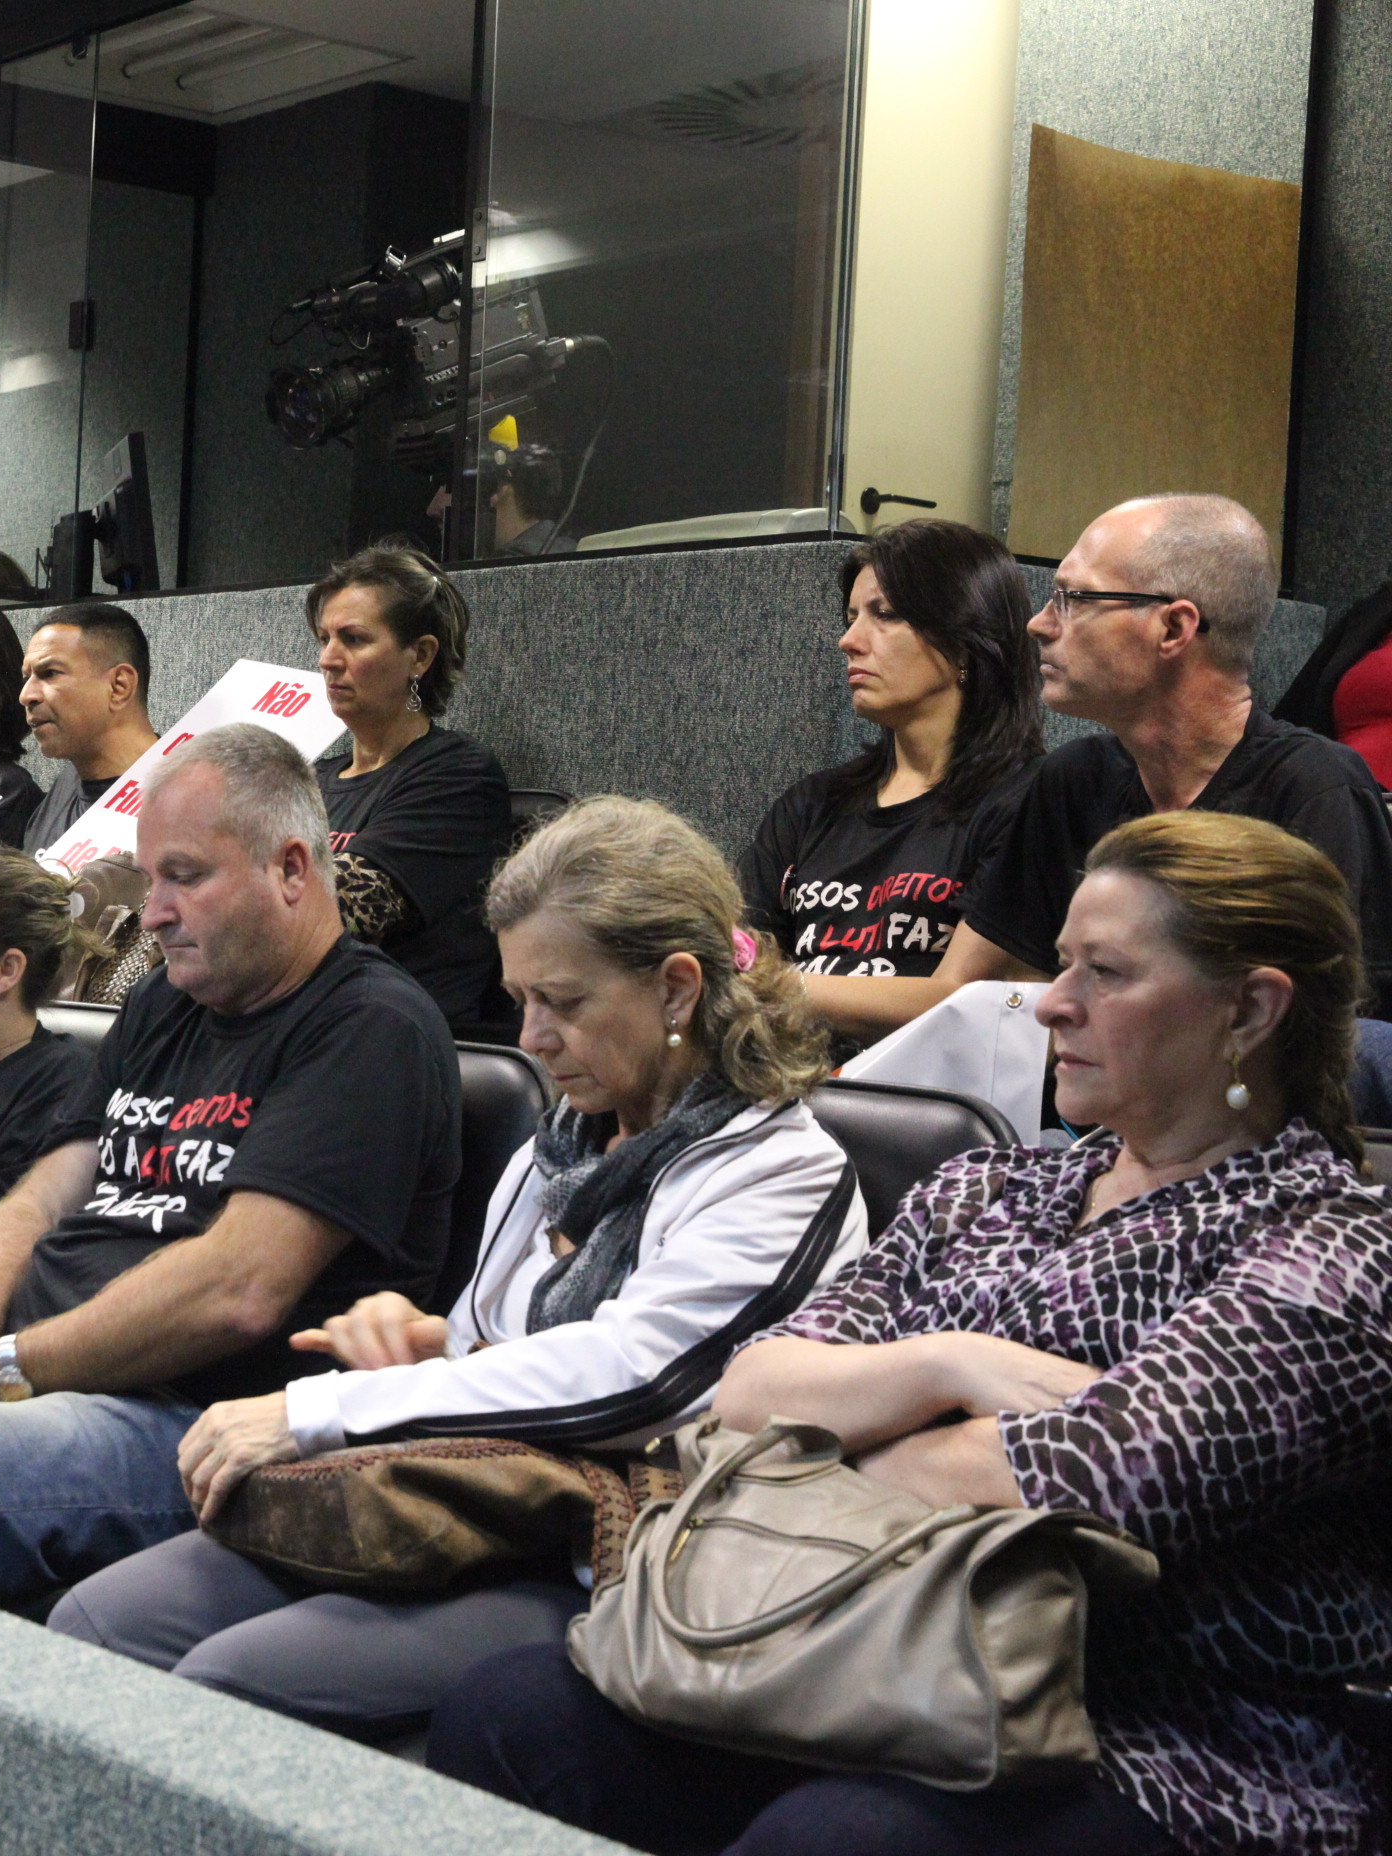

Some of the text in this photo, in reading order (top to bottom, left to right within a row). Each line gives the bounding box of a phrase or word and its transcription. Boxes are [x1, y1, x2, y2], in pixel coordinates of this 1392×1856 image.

[251, 681, 312, 718] Não
[819, 916, 884, 954] LUT
[887, 912, 956, 953] FAZ
[175, 1139, 236, 1187] FAZ
